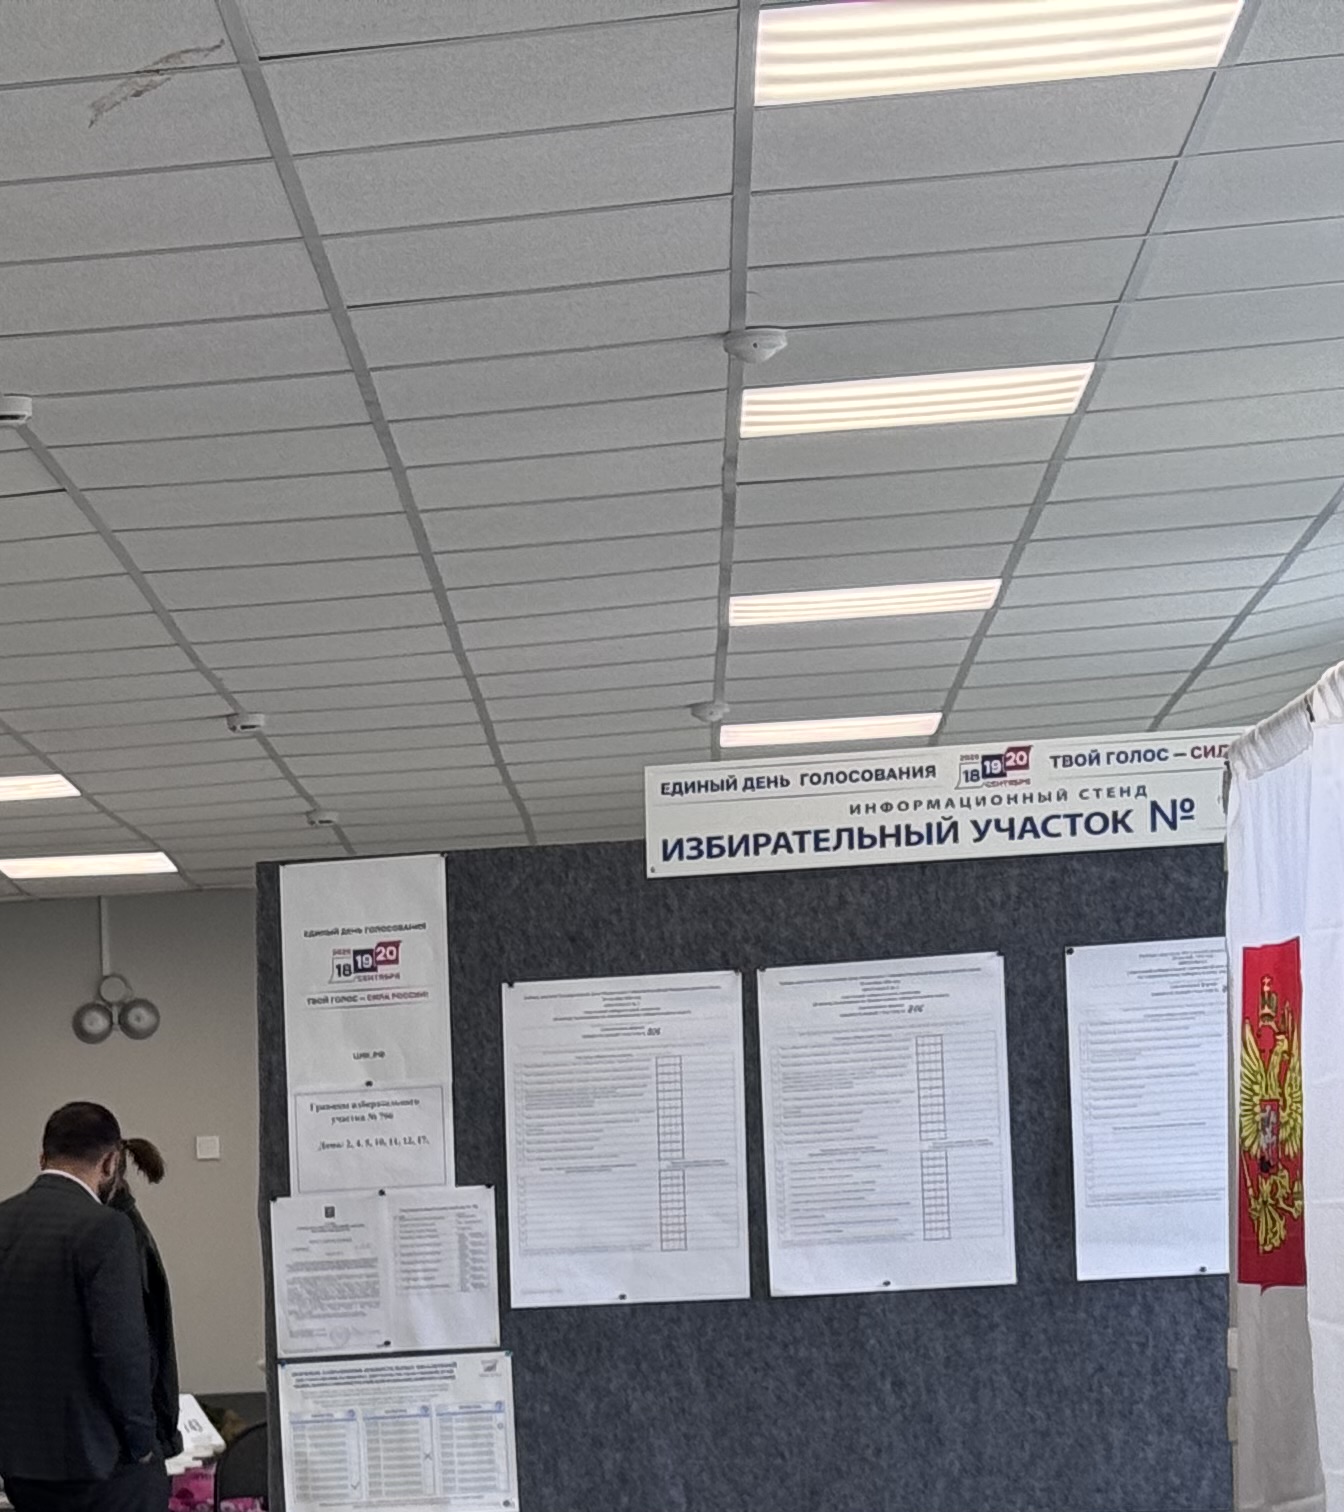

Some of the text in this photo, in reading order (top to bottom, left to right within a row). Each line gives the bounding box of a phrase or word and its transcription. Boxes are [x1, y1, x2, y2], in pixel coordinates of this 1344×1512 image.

[962, 750, 1028, 783] 18 19 20
[1049, 748, 1101, 769] ТВОЙ
[1106, 747, 1169, 767] ГОЛОС
[1190, 743, 1229, 760] СИЛ
[661, 764, 937, 796] ЕДИНЫЙ ДЕНЬ ГОЛОСОВАНИЯ
[850, 785, 1148, 815] ИНФОРМАЦИОННЫЙ СТЕНД
[662, 797, 1196, 862] ИЗБИРАТЕЛЬНЫЙ УЧАСТОК №
[335, 946, 397, 978] 18 19 20
